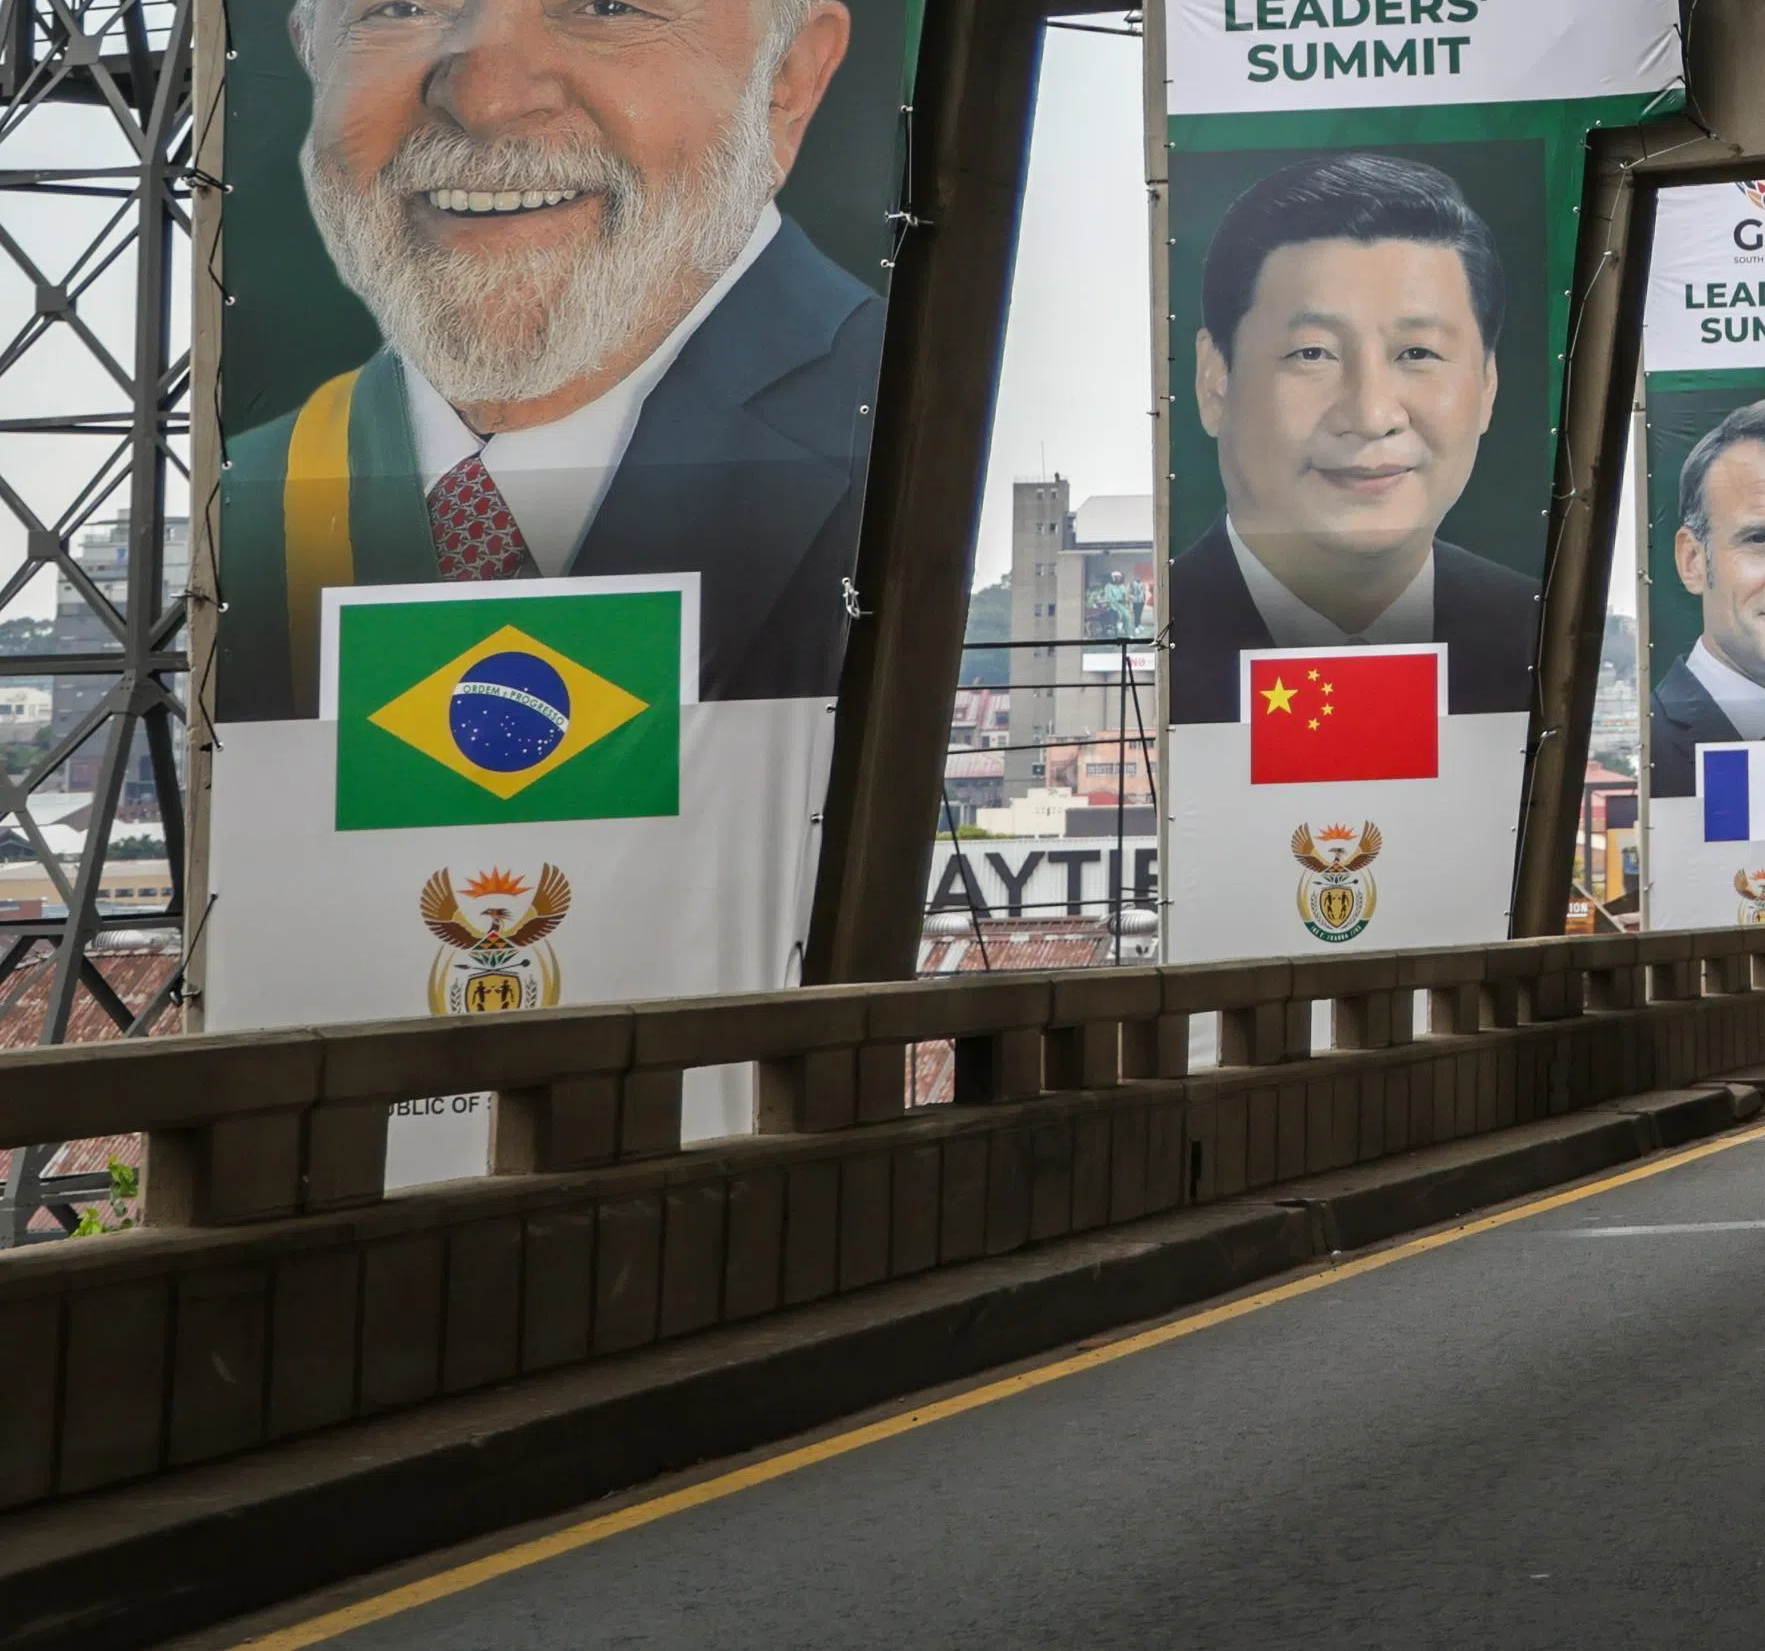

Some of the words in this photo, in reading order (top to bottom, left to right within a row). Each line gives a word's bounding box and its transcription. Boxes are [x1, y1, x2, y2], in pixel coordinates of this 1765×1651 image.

[1247, 36, 1471, 83] SUMMIT
[1733, 256, 1764, 264] SOUTH
[462, 684, 500, 695] ORDEM
[510, 690, 565, 726] PROGRESSO
[451, 1095, 481, 1114] OF
